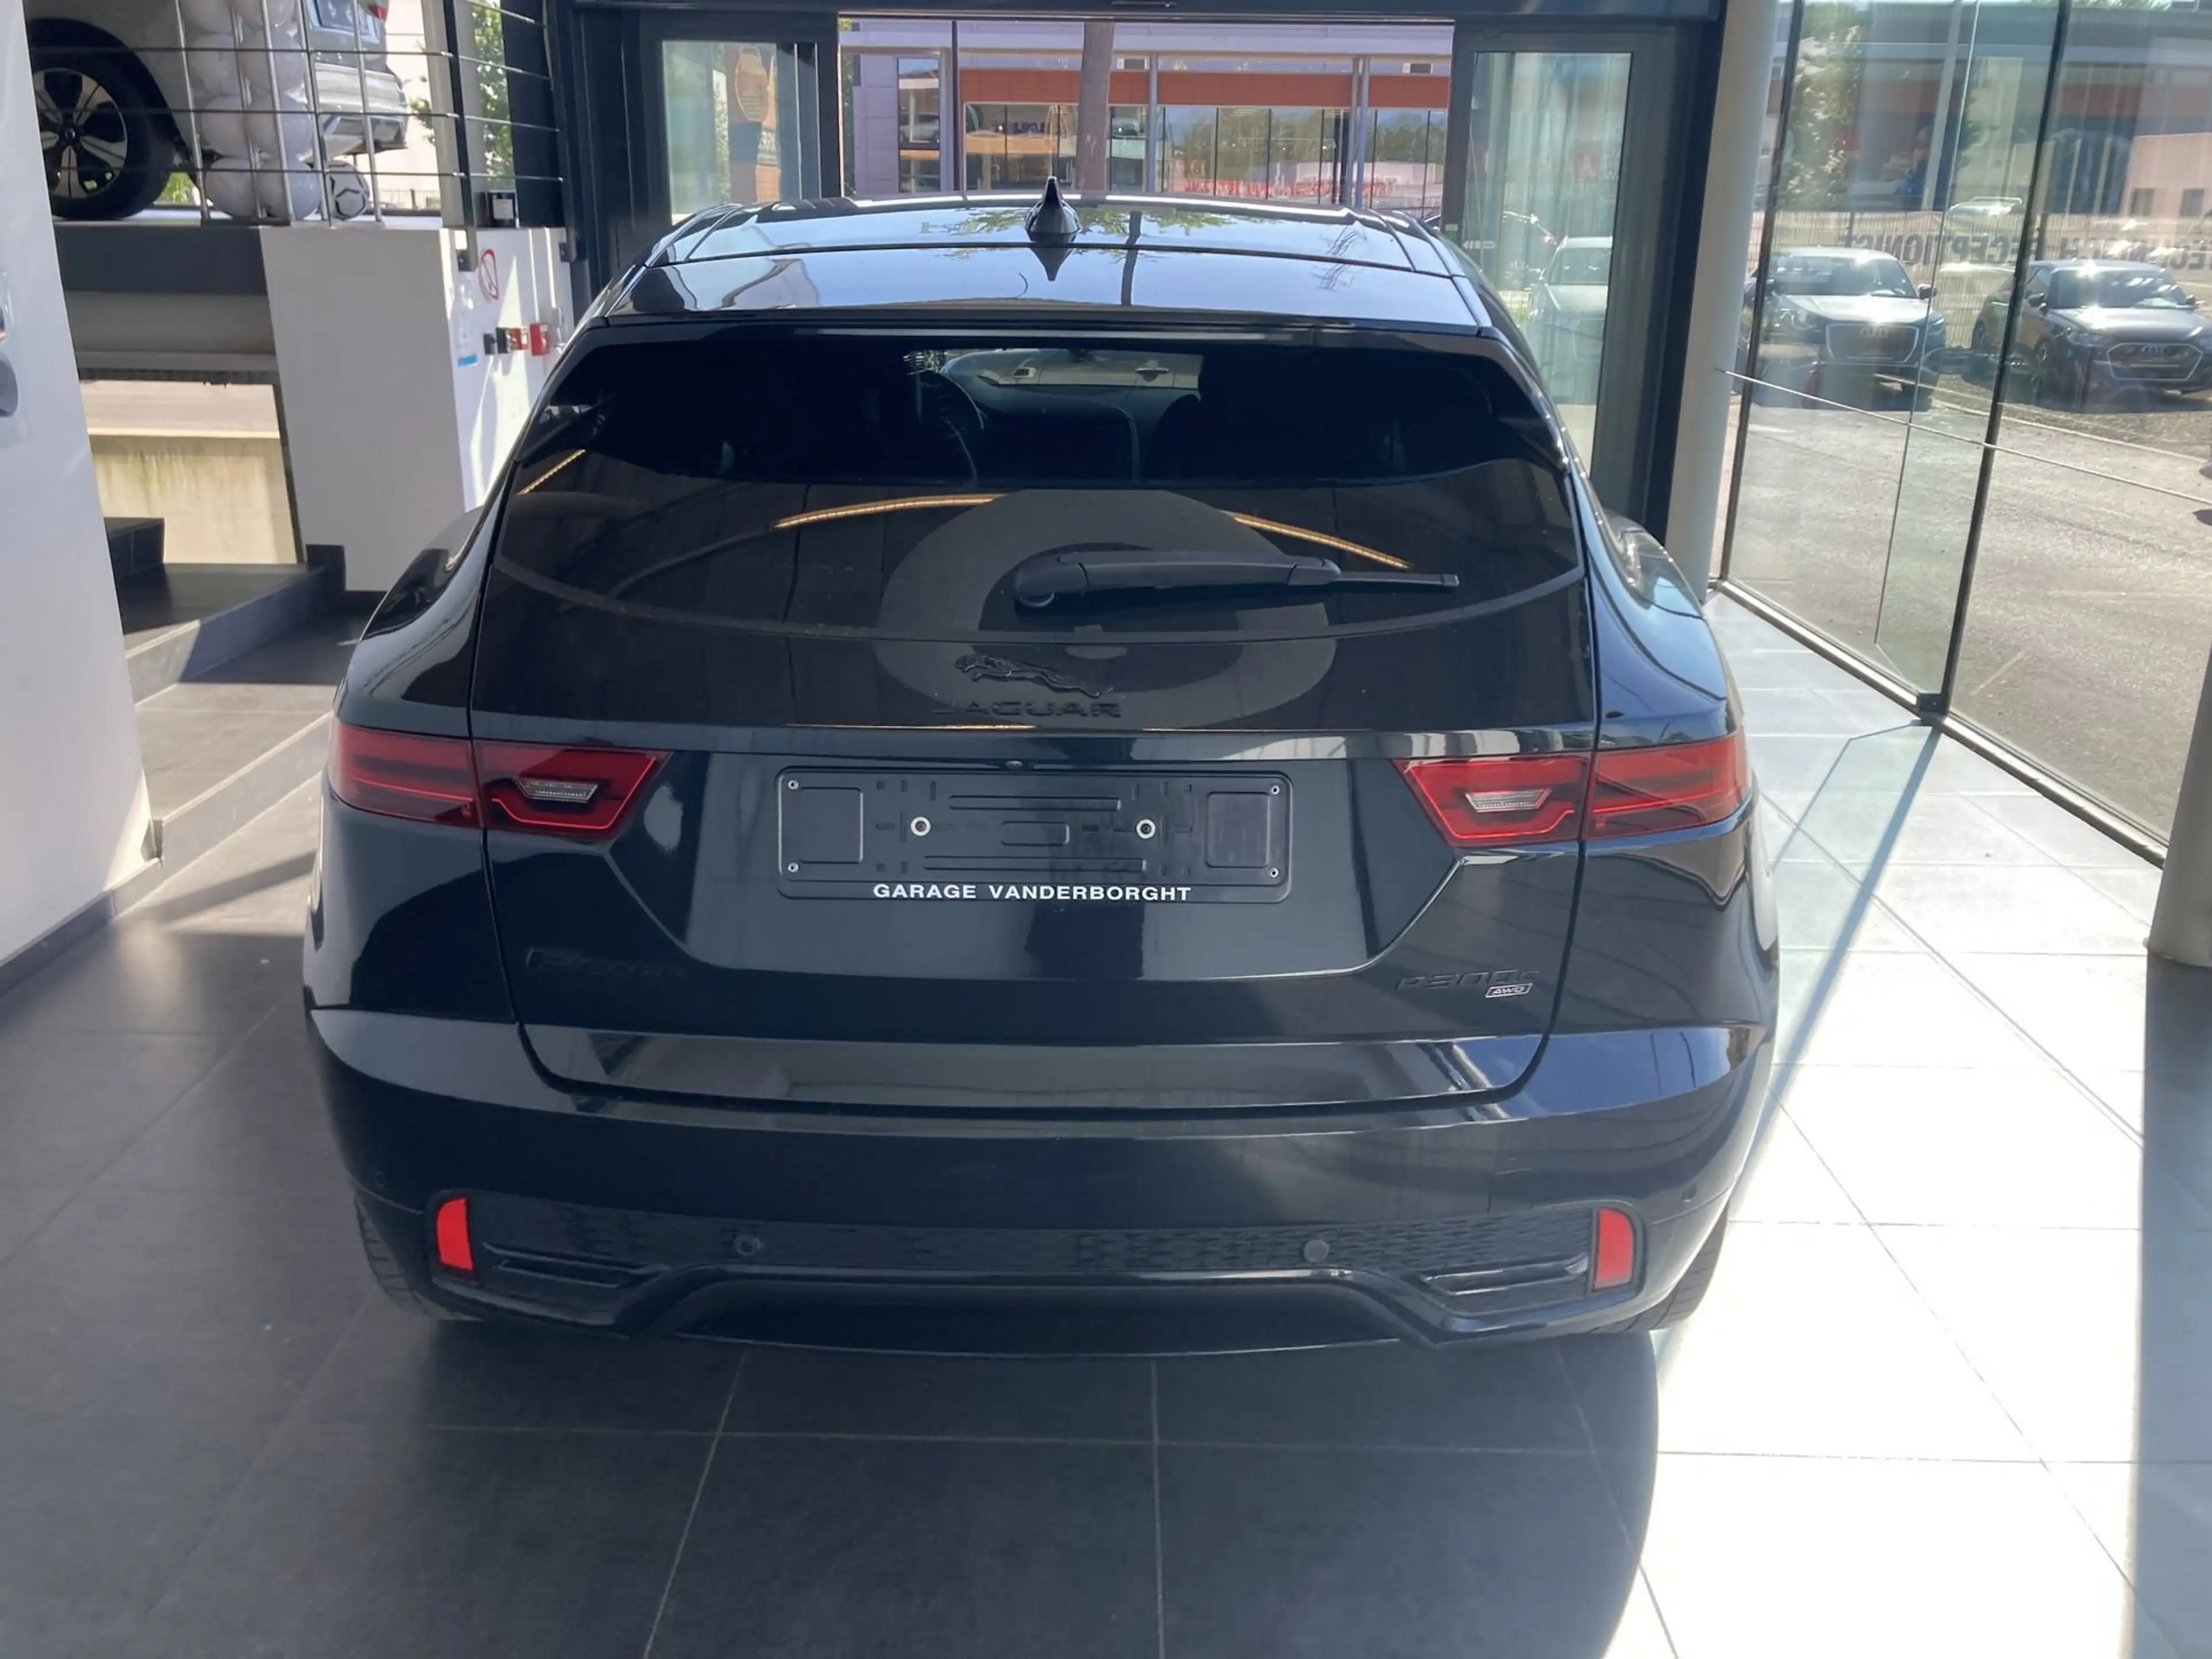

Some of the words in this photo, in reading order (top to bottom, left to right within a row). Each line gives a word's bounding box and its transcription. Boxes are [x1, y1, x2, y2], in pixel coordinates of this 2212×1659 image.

[930, 700, 1122, 718] JAGUAR
[873, 884, 976, 899] GARAGE
[988, 885, 1192, 901] VANDERBORGHT
[1490, 986, 1527, 995] AWD
